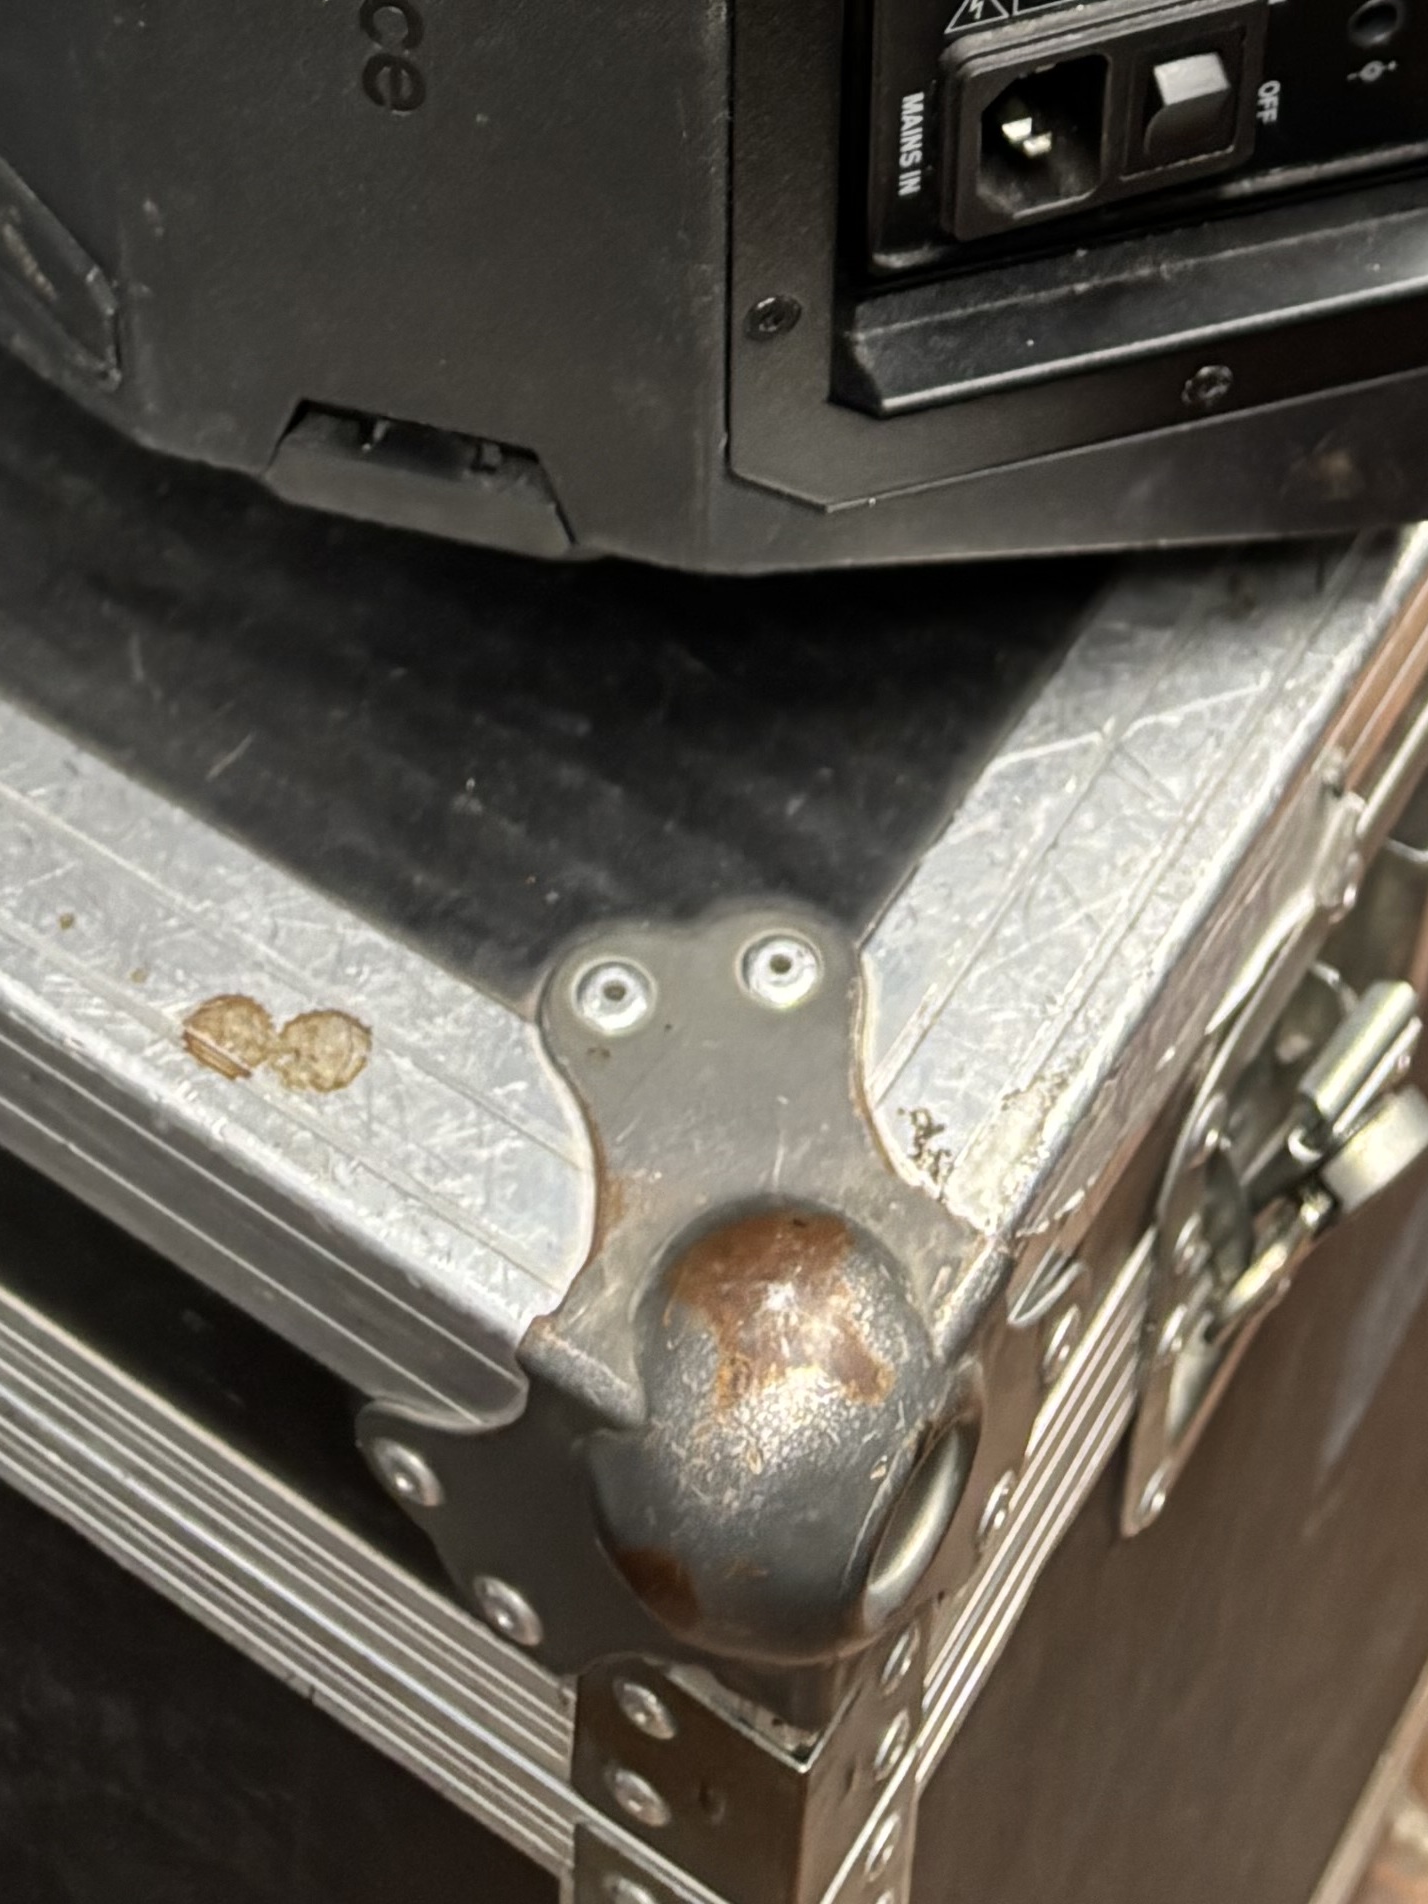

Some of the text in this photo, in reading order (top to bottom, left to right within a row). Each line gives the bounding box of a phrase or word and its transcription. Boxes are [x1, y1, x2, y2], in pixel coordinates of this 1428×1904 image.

[1256, 79, 1282, 125] OFF
[898, 90, 925, 197] MAINS IN
